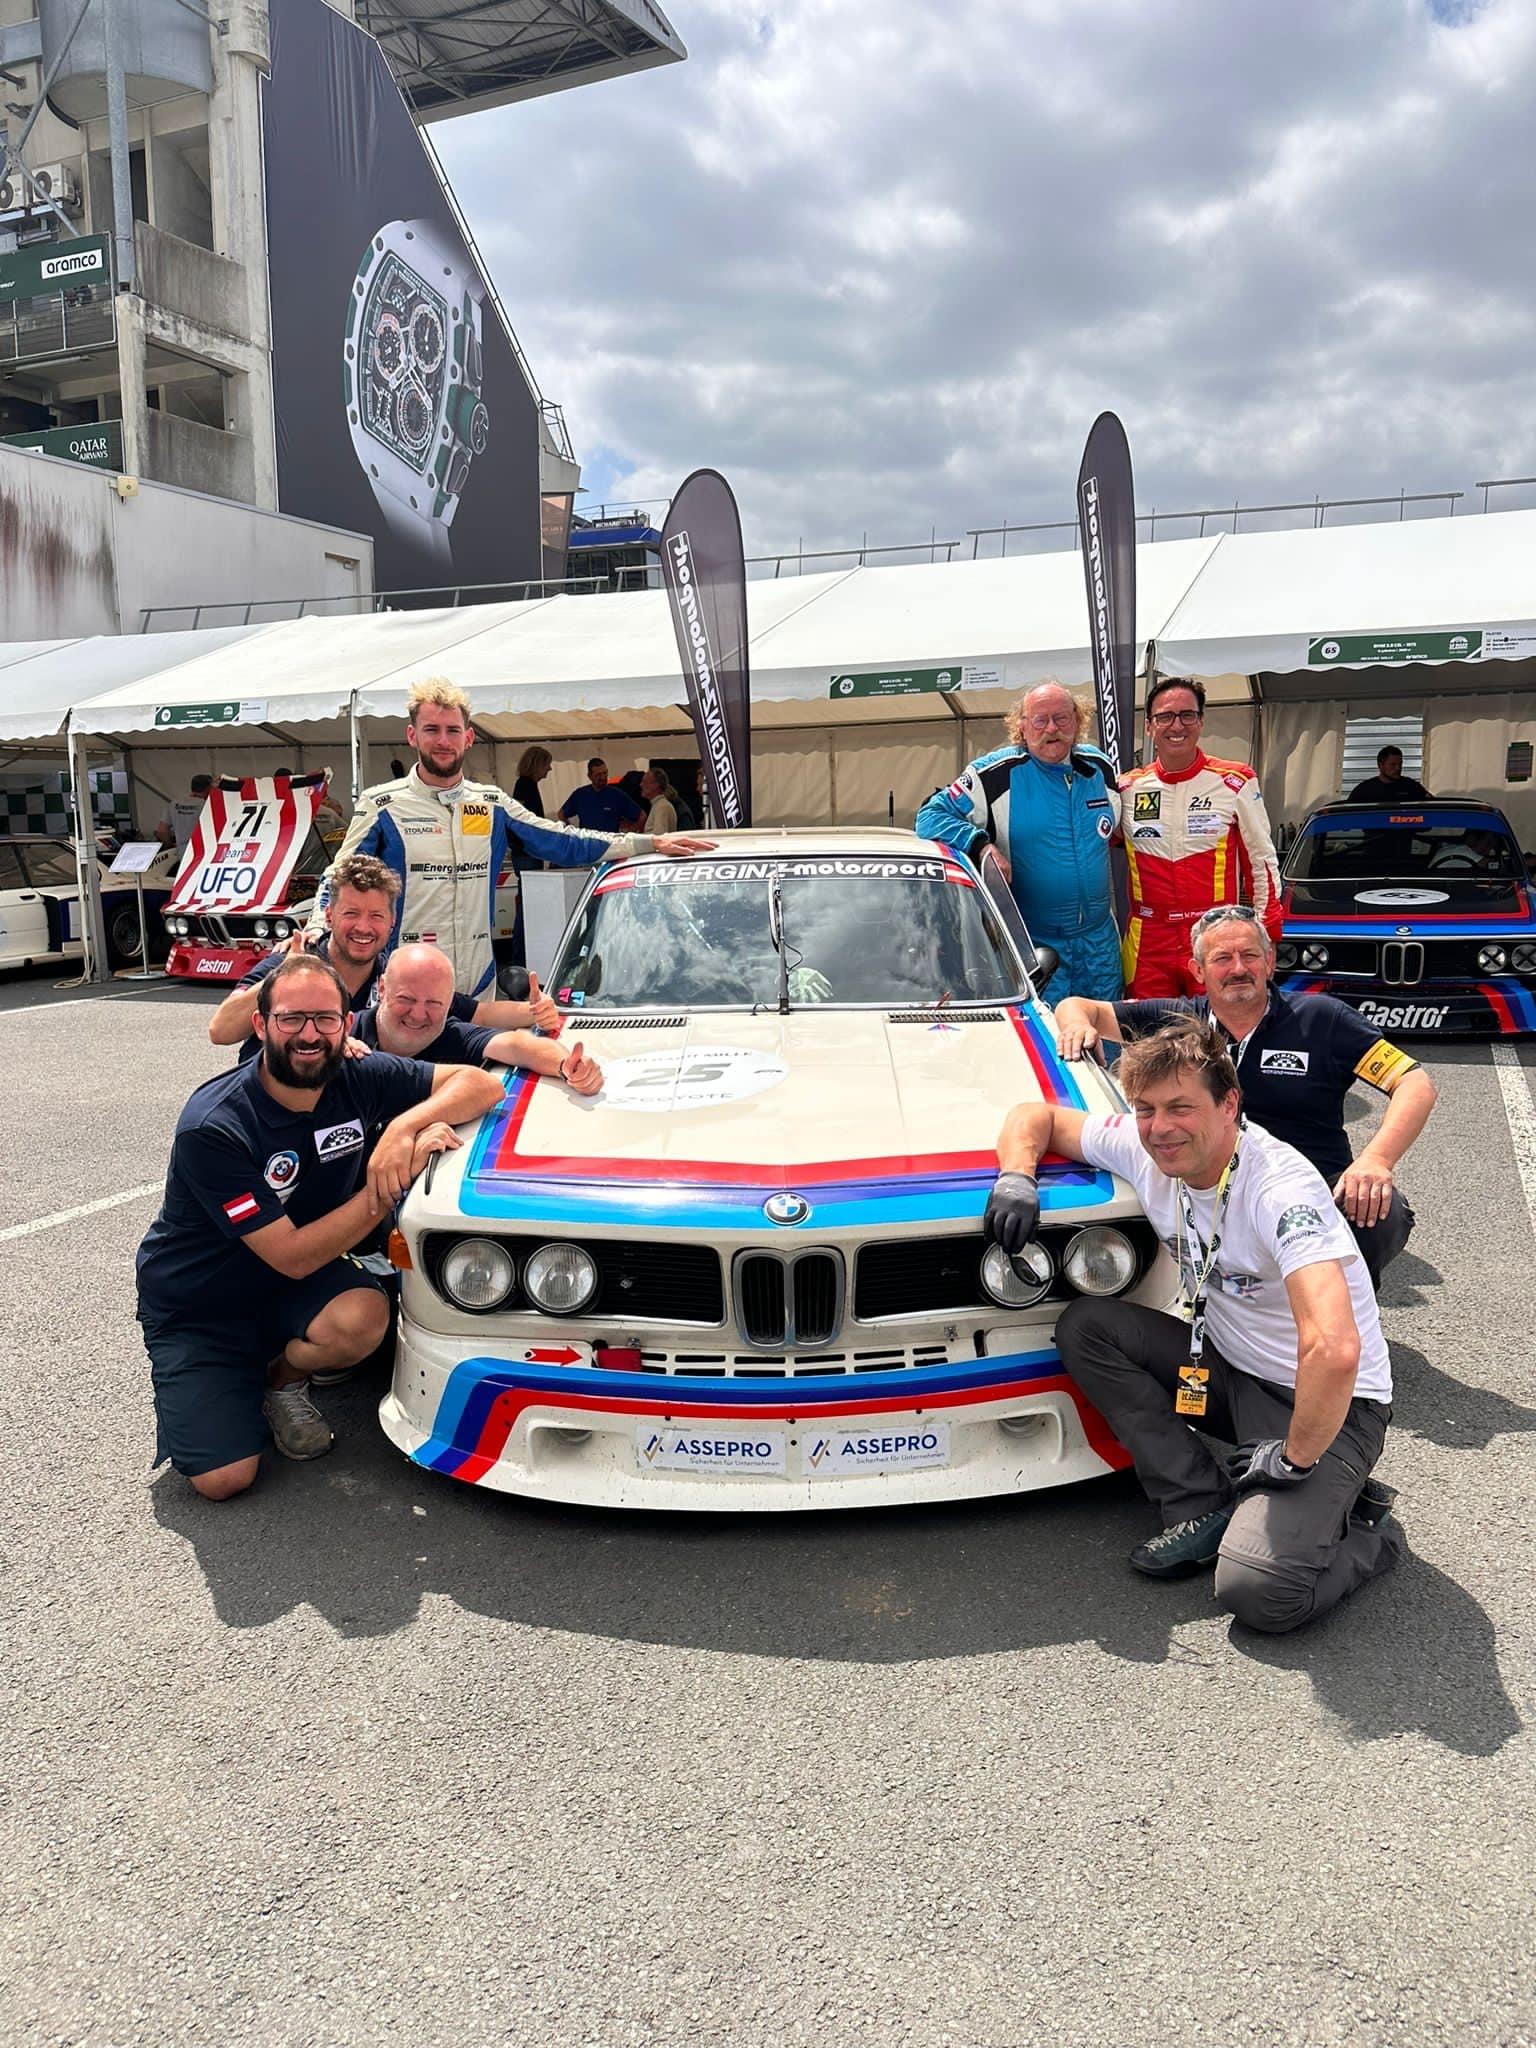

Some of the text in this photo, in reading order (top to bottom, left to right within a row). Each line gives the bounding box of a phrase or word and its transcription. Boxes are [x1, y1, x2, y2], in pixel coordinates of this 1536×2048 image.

[47, 254, 97, 274] aramco
[69, 437, 108, 455] QATAR
[79, 450, 108, 461] AIRWAYS
[463, 804, 489, 816] ADAC
[233, 805, 268, 837] 71
[793, 861, 939, 877] motorsport
[199, 867, 257, 894] UFO
[195, 958, 234, 975] Castrol
[1358, 1000, 1450, 1028] Castrol
[624, 1062, 732, 1087] 25
[674, 1439, 772, 1458] ASSEPRO
[841, 1434, 938, 1455] ASSEPRO
